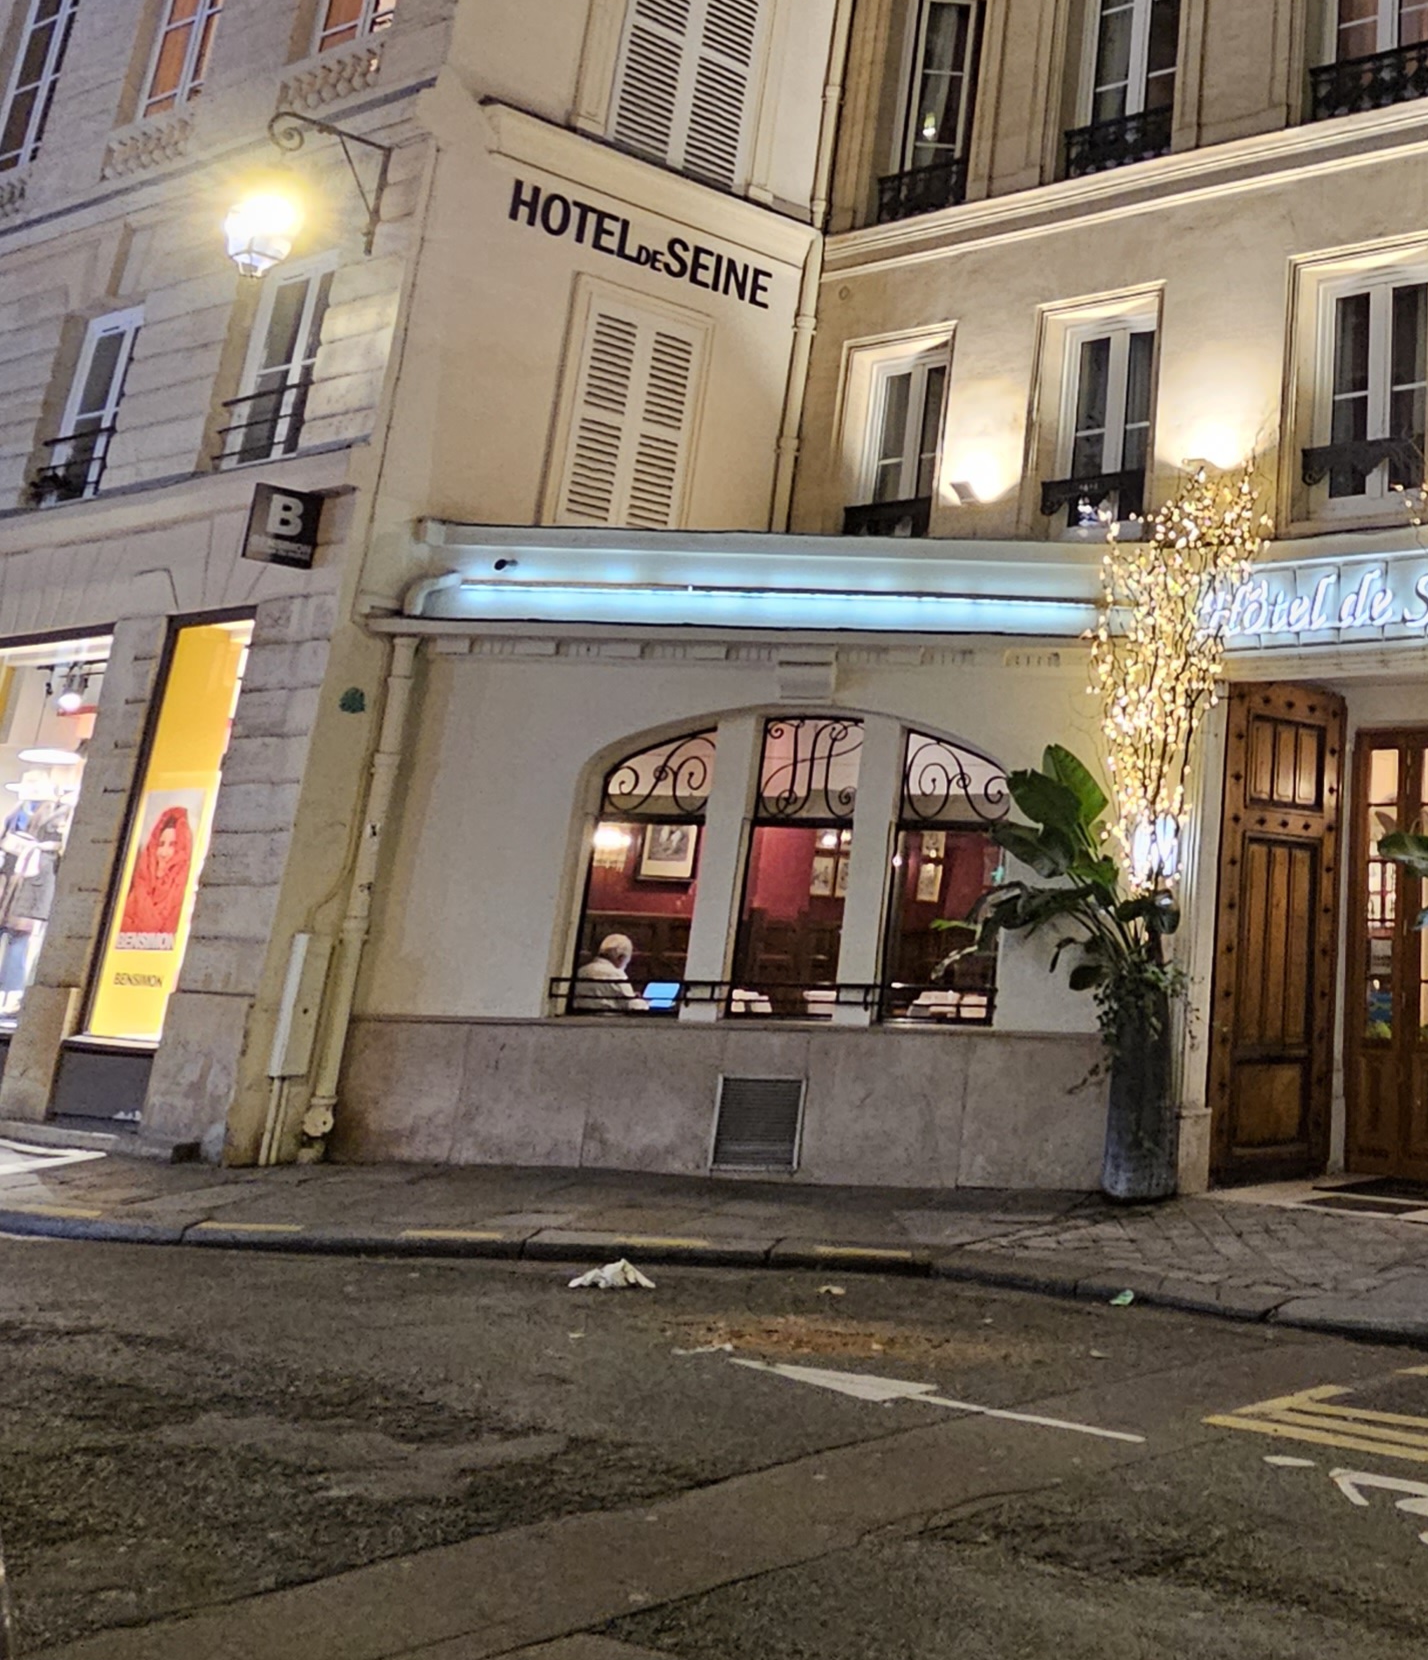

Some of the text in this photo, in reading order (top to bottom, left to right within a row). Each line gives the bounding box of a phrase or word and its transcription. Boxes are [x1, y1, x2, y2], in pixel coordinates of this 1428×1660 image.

[508, 178, 639, 263] HOTEL
[662, 237, 773, 310] SEINE
[265, 493, 304, 537] B
[1339, 568, 1394, 629] de
[113, 971, 163, 988] BENSIMON
